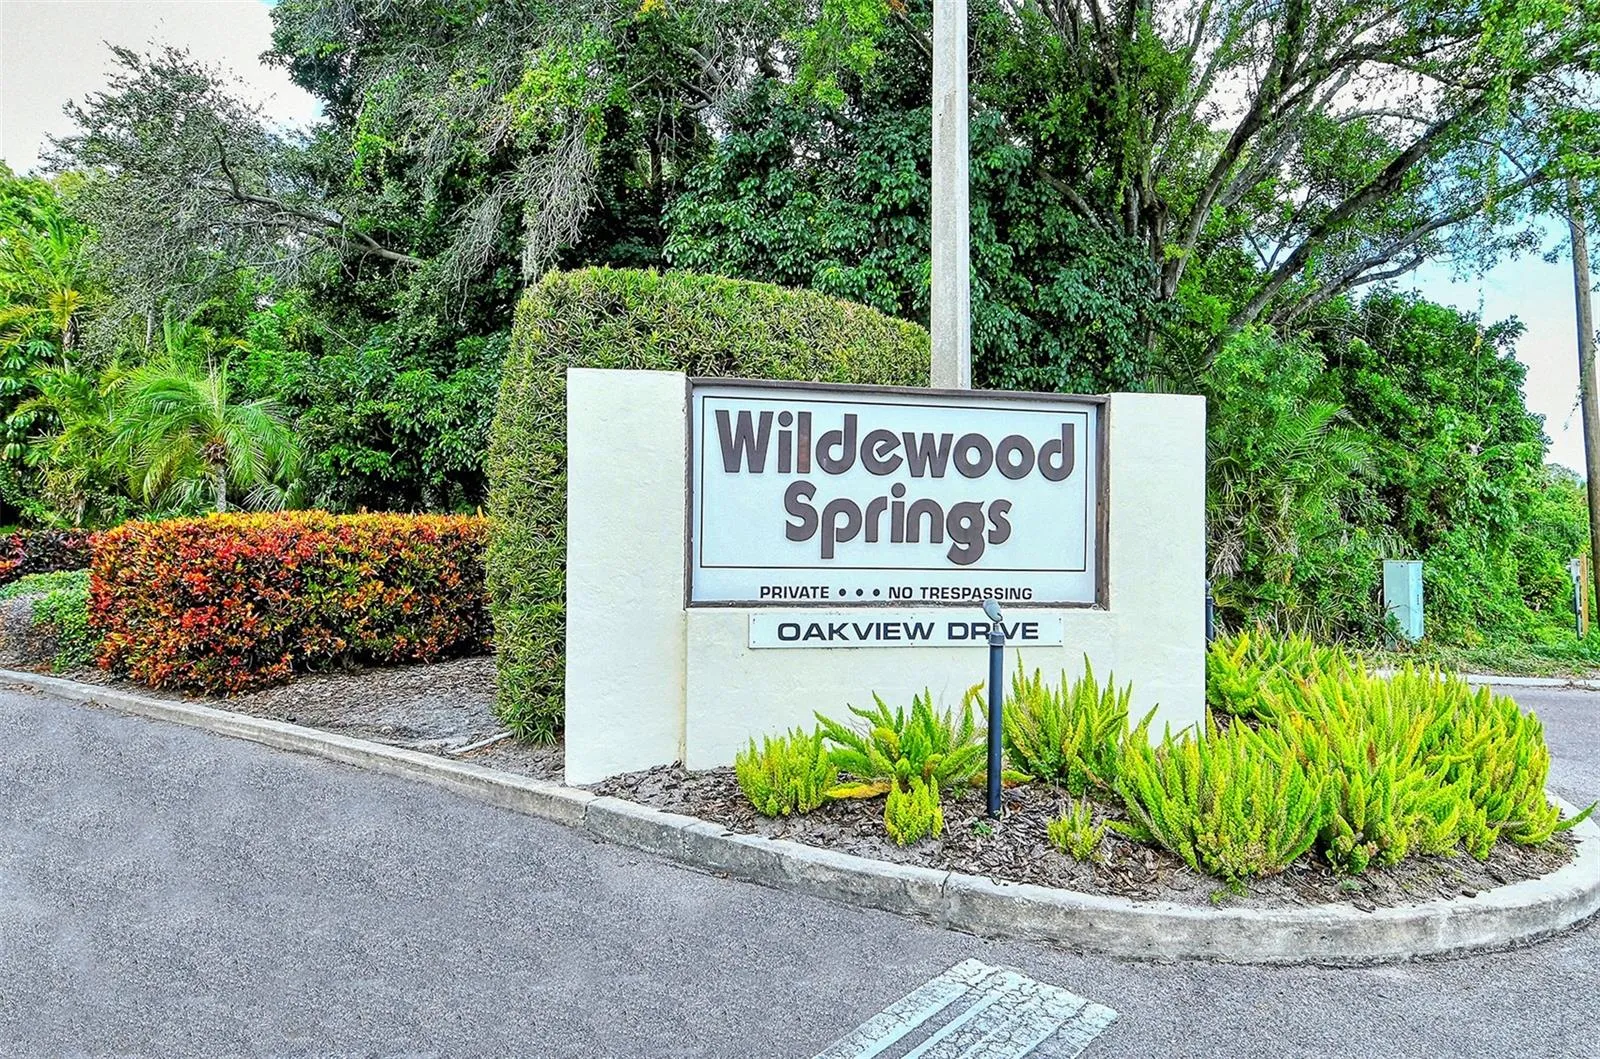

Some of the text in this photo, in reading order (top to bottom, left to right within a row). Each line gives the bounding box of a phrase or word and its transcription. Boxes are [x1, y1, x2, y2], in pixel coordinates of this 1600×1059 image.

[714, 409, 1075, 482] Wildewood
[783, 480, 1013, 566] Springs
[759, 585, 1033, 601] PRIVATE NO TRESPASSING
[777, 622, 936, 641] OAKVIEW
